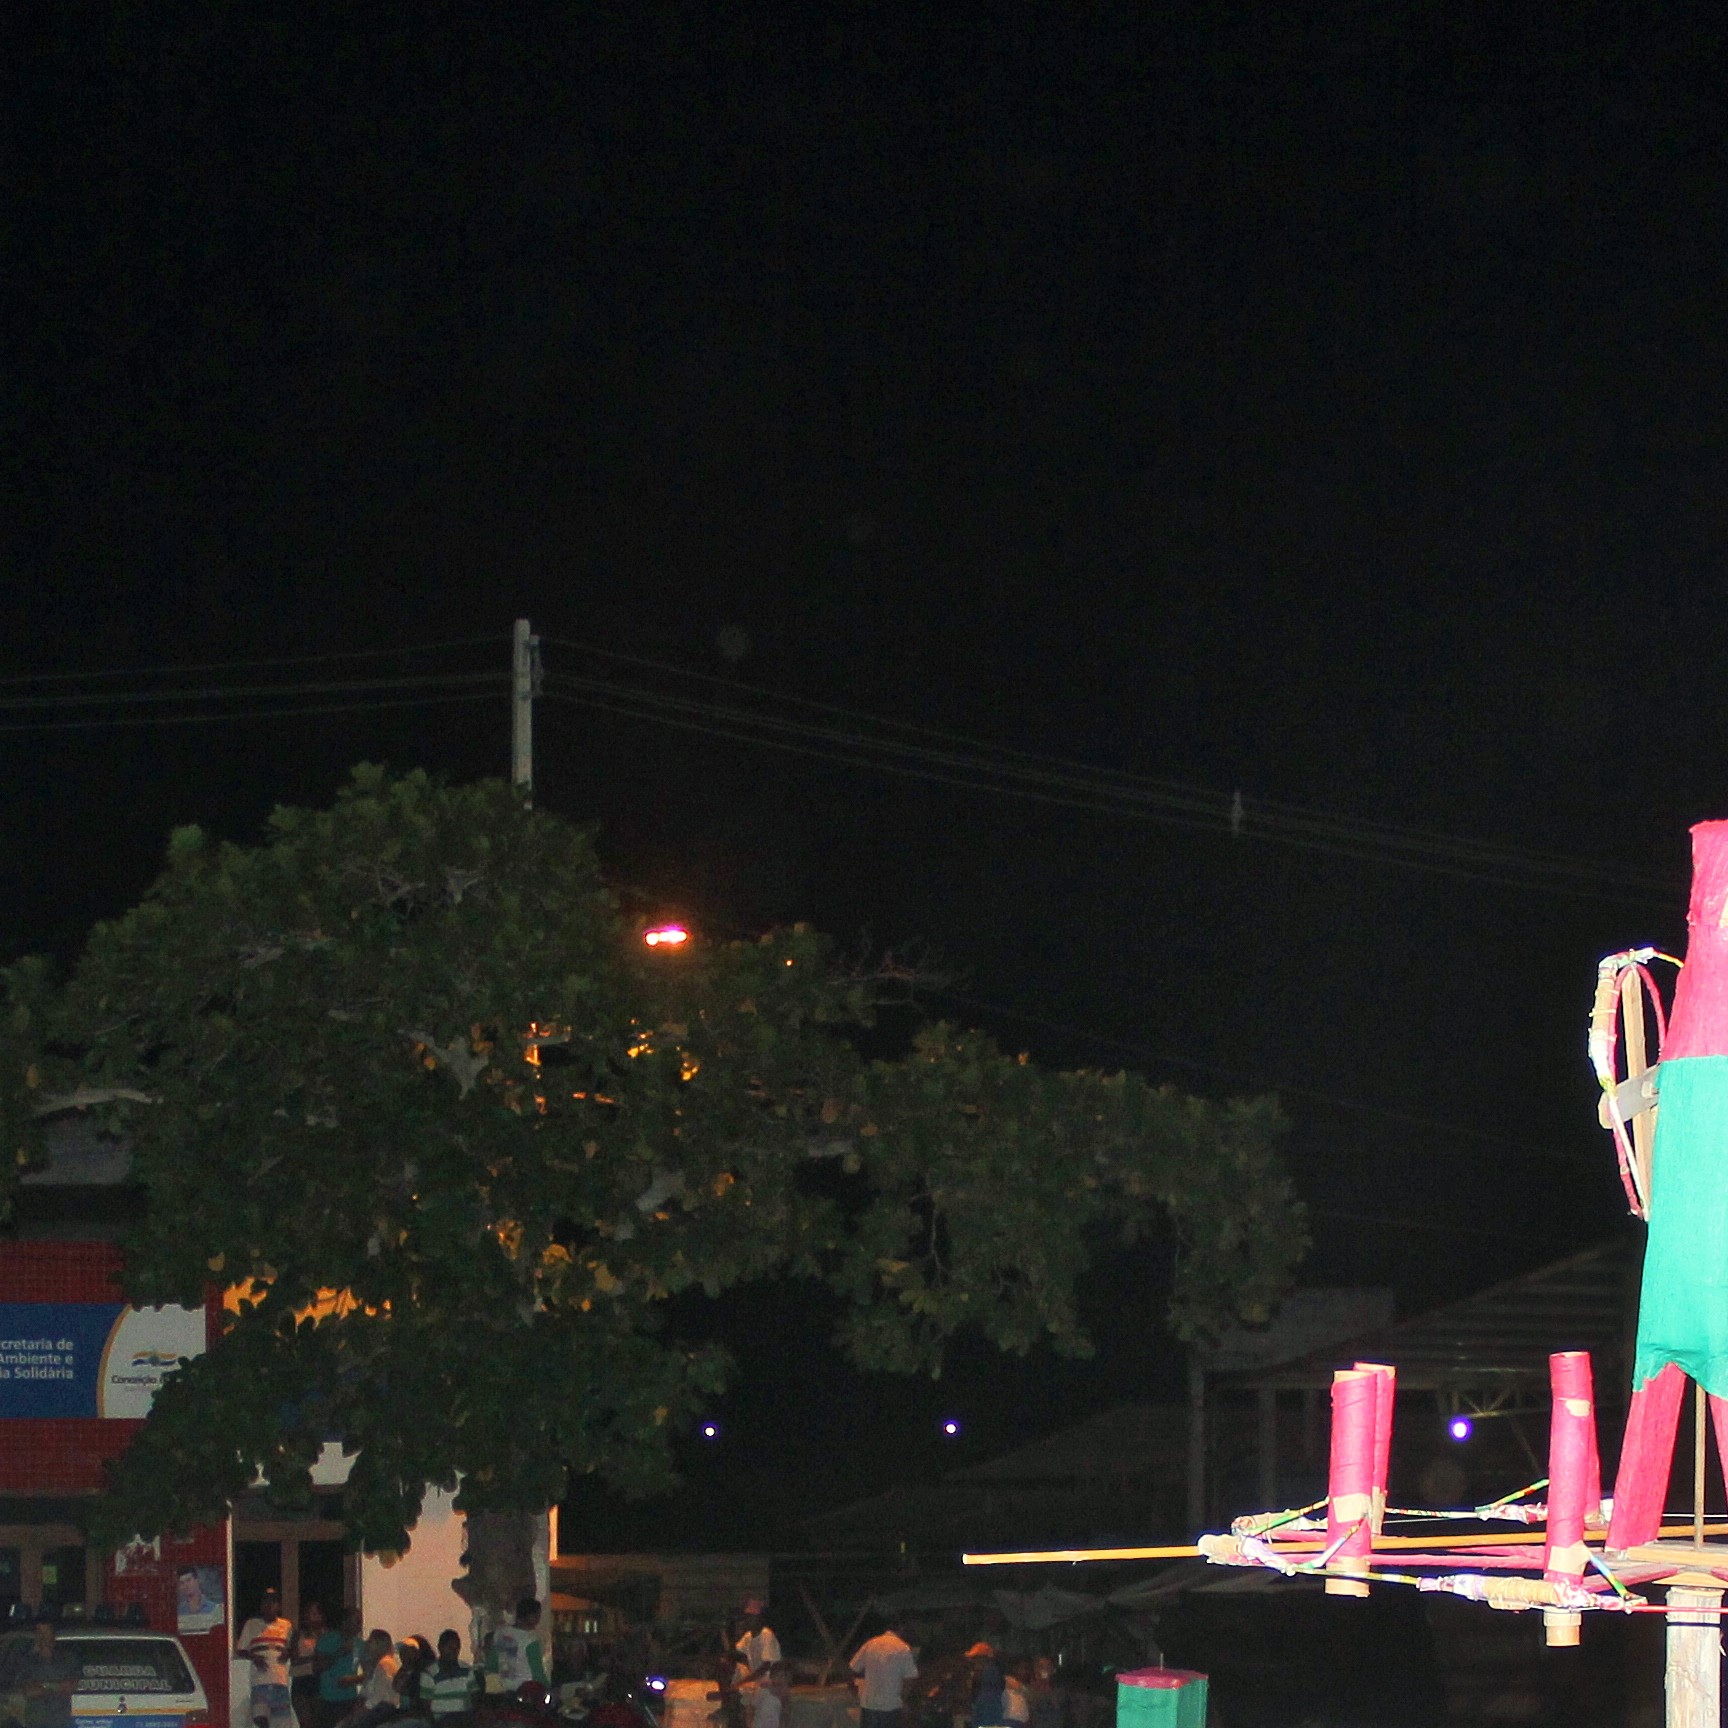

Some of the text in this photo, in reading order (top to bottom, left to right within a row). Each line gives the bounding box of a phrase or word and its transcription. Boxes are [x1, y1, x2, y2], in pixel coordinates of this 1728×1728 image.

[57, 1337, 74, 1351] de
[65, 1355, 74, 1366] e
[14, 1366, 74, 1380] Solidária
